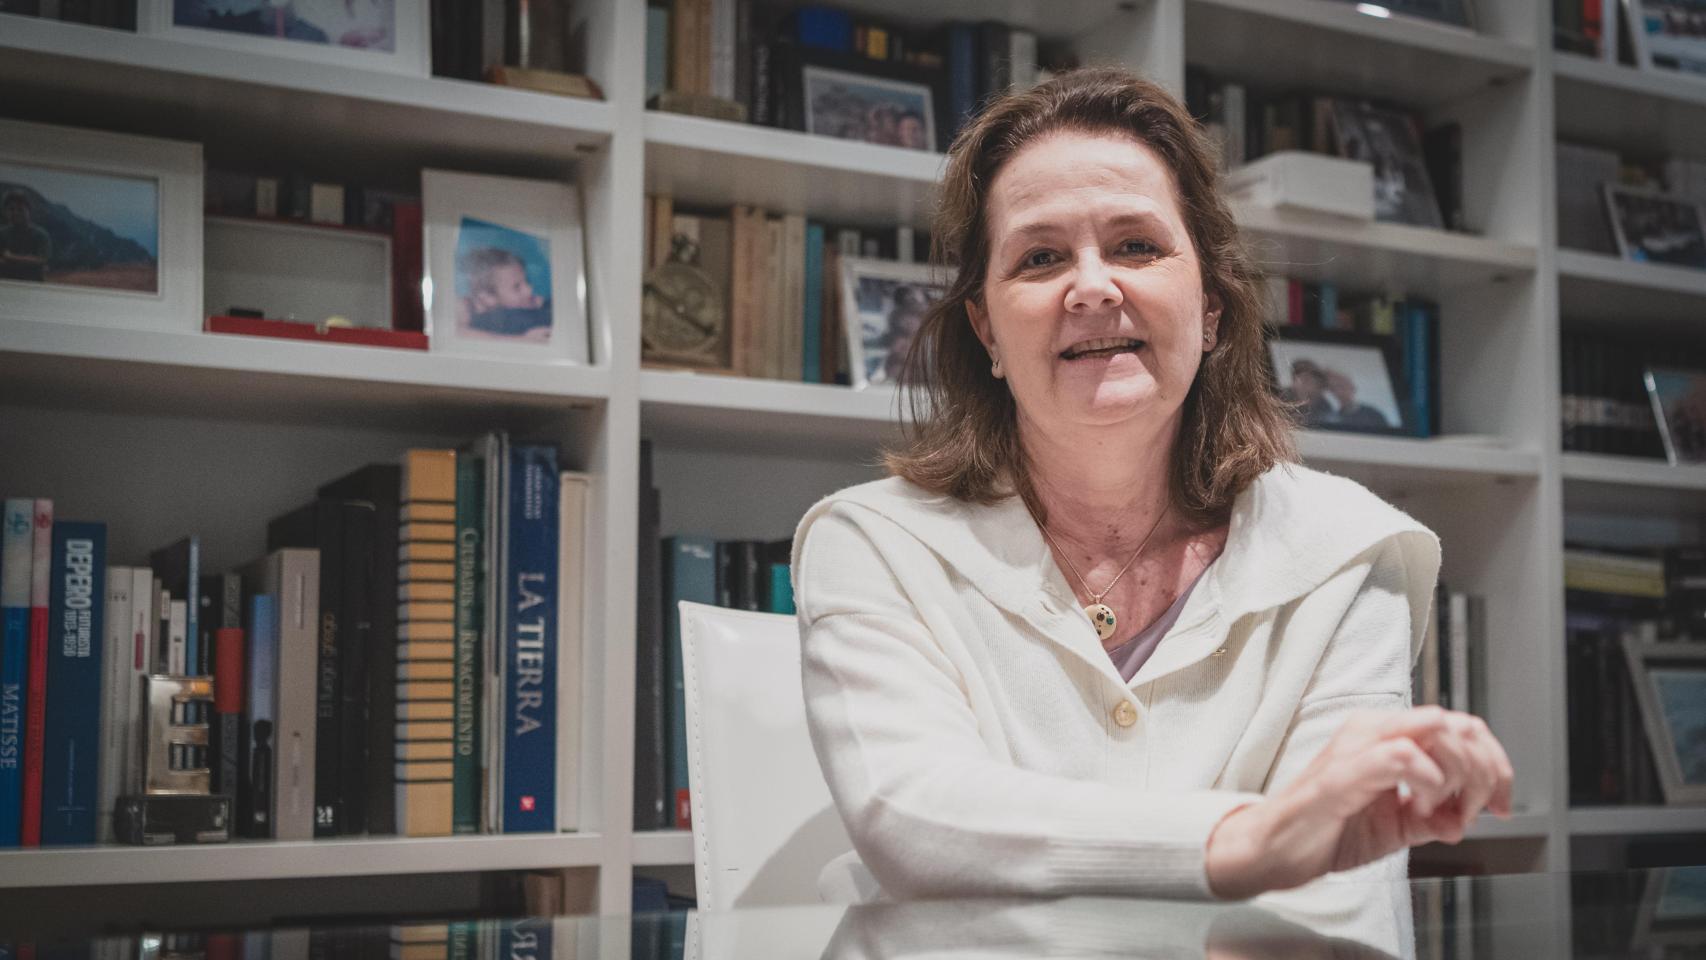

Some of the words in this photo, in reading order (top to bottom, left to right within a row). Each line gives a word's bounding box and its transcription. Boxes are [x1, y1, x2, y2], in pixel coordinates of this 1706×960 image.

[65, 539, 93, 609] DEPERO
[518, 572, 545, 612] LA
[77, 610, 91, 657] FUTURISTA
[515, 616, 545, 736] TIERRA
[1, 683, 19, 769] MATISSE
